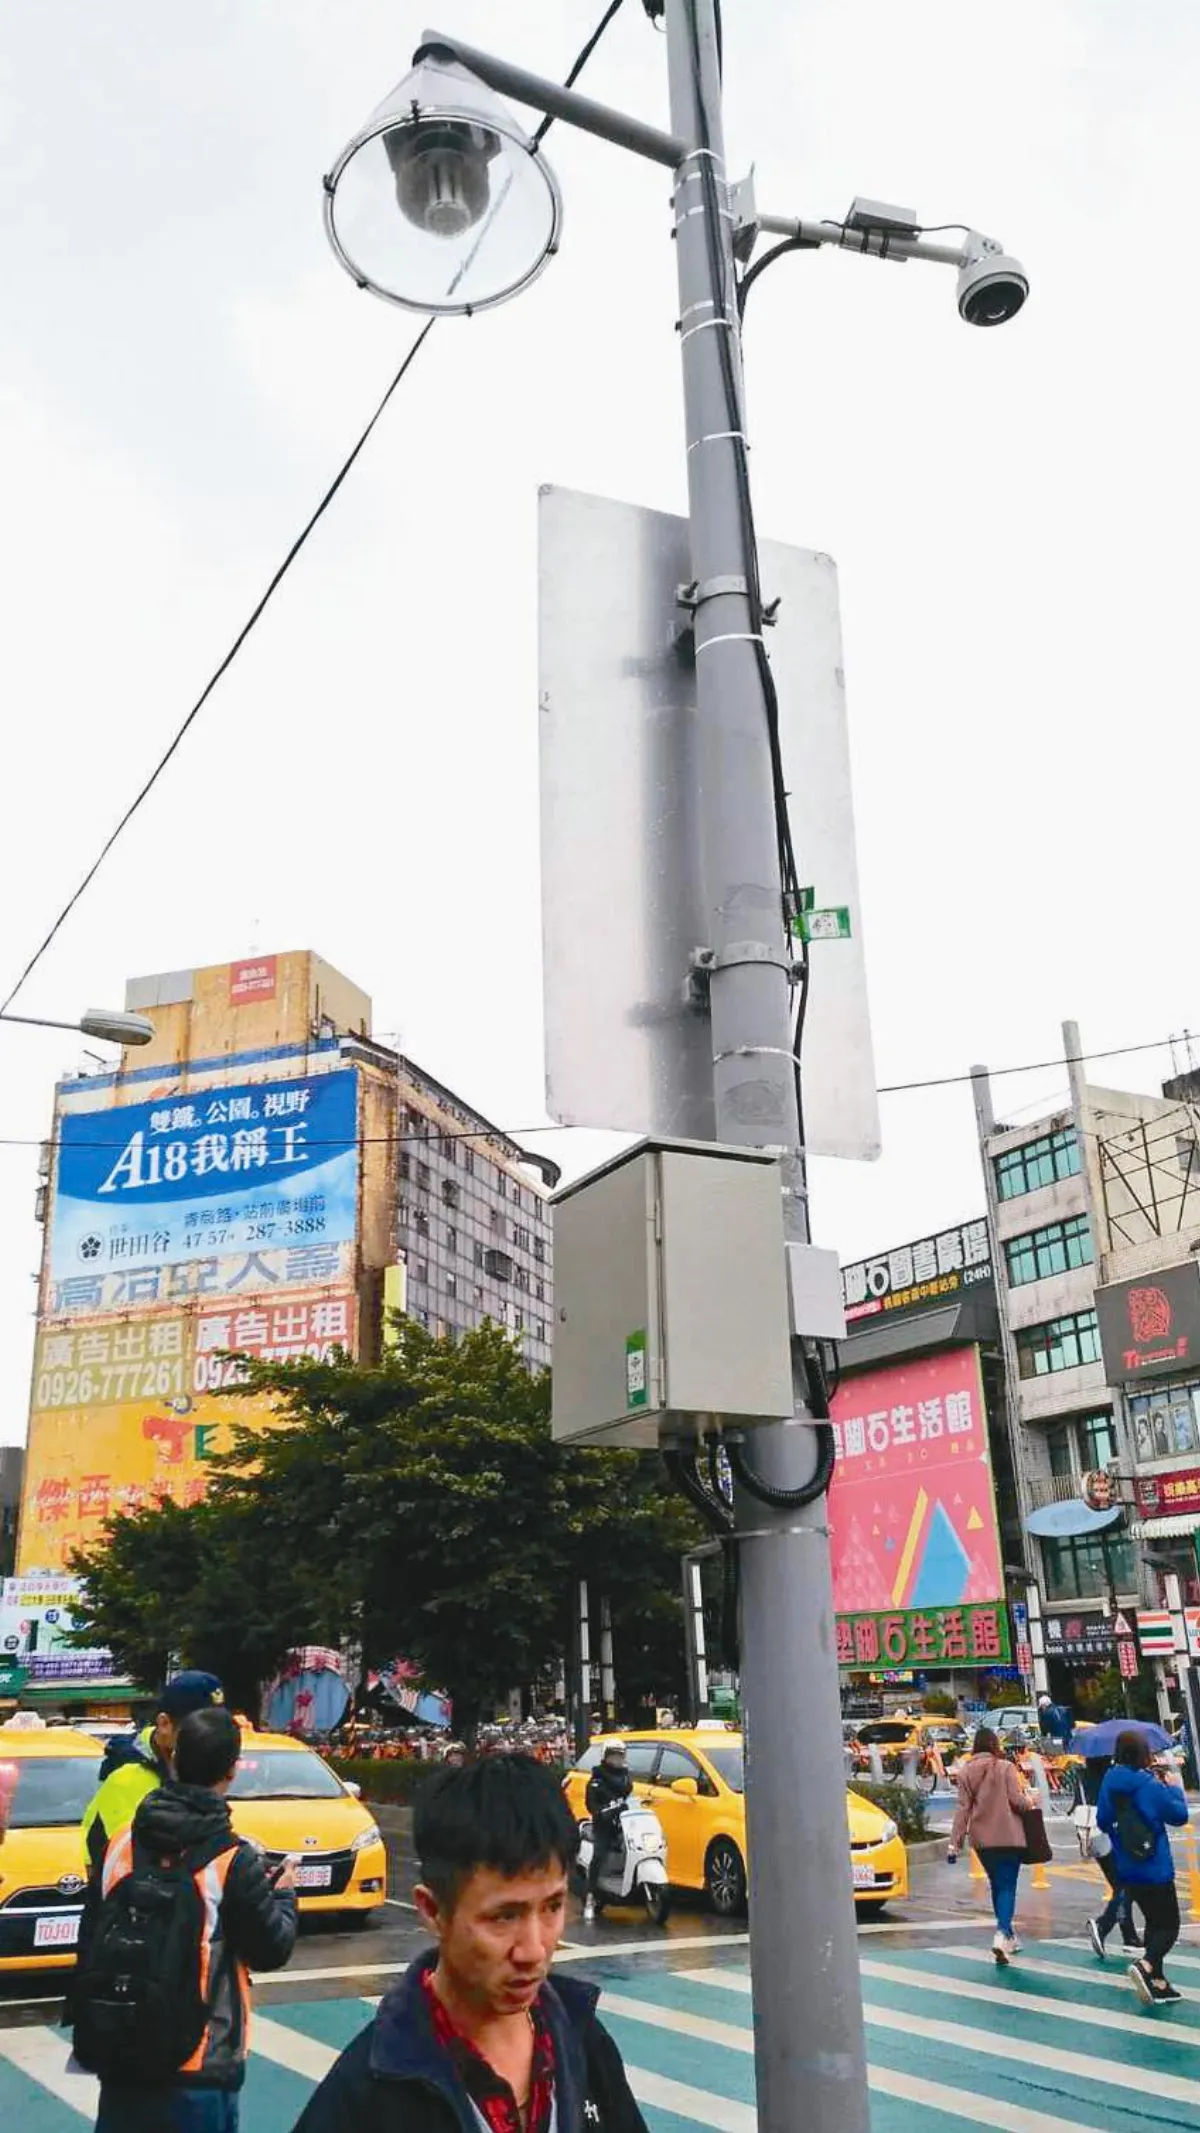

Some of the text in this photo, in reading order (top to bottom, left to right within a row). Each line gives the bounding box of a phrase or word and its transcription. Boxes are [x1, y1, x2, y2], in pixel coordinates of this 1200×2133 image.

[97, 1121, 309, 1193] A18我稱王
[246, 1216, 326, 1241] 287-3888
[841, 1220, 990, 1306] 腳石圖書廣場
[42, 1321, 184, 1370] 廣告出租
[196, 1302, 348, 1353] 廣告出租
